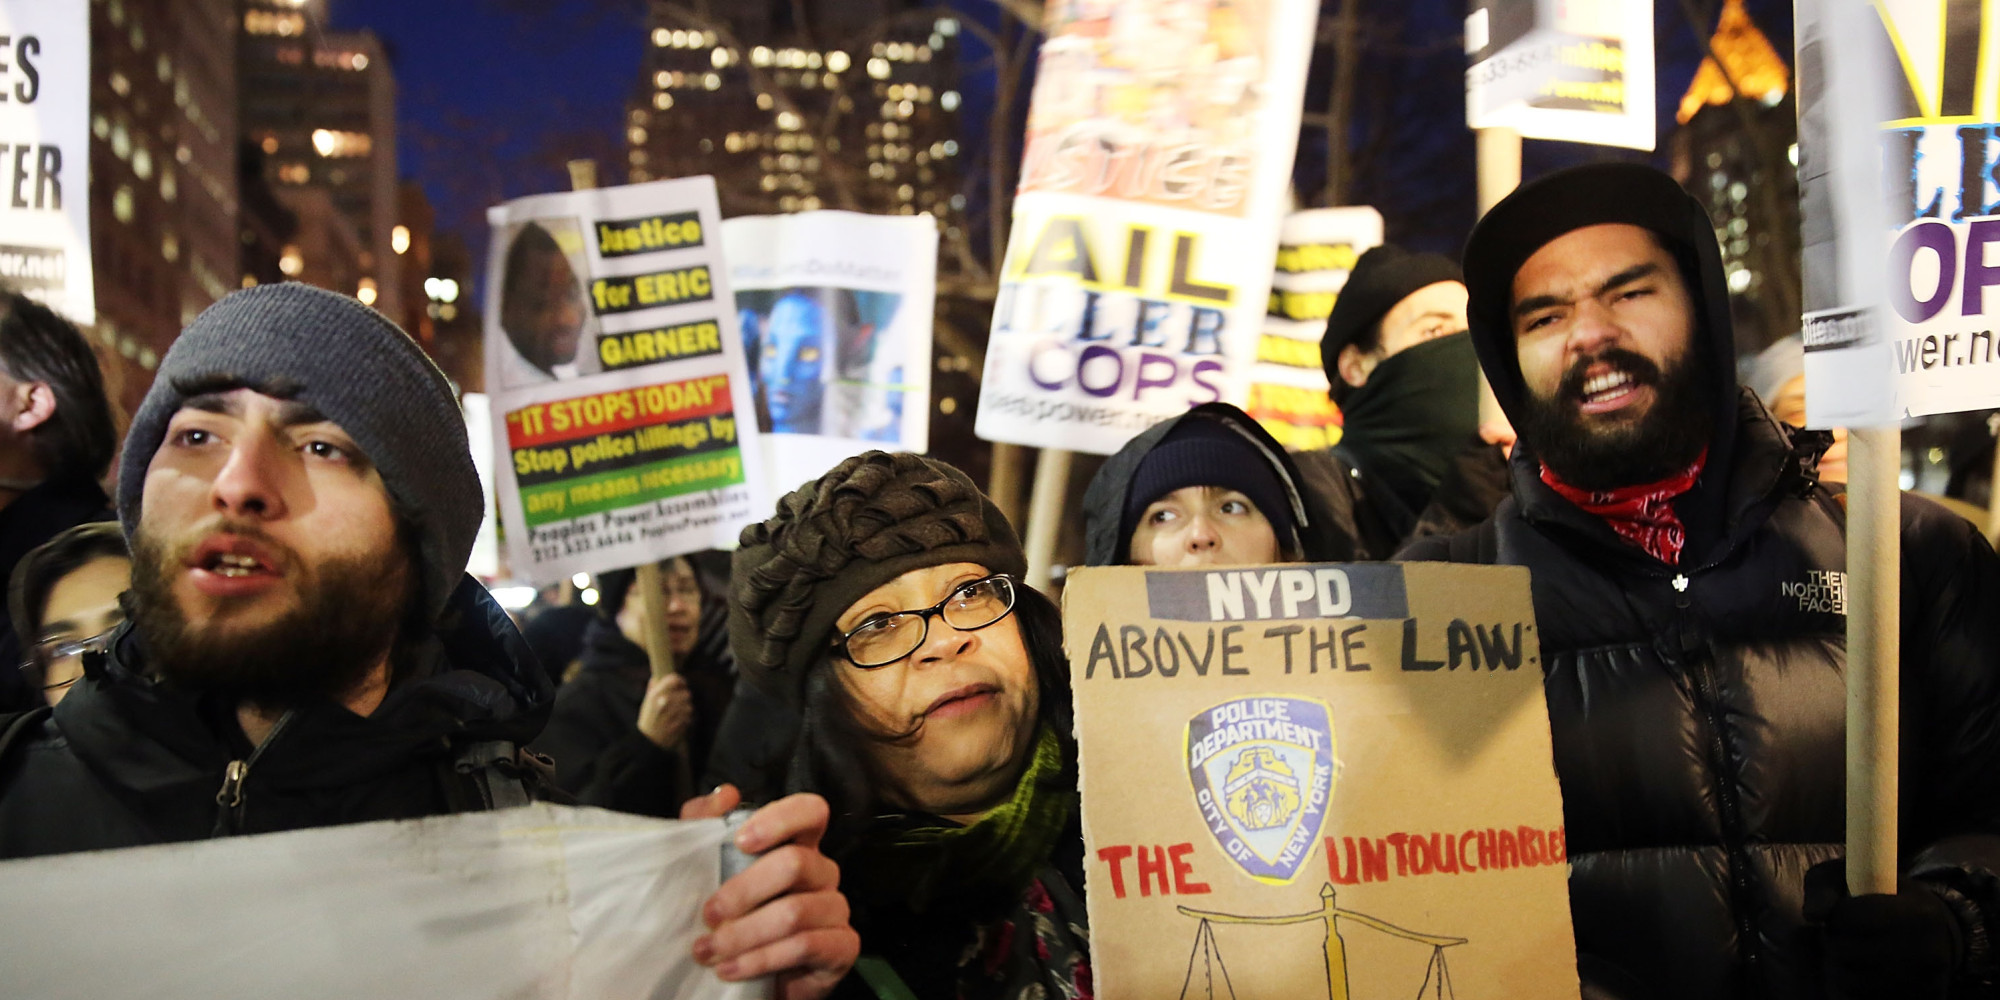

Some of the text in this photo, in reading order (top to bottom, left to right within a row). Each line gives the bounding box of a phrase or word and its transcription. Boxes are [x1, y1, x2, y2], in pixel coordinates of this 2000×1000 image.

[601, 217, 701, 252] Justice
[592, 267, 711, 309] for ERIC
[601, 322, 720, 366] GARNER
[1028, 338, 1225, 411] COPS
[513, 446, 568, 475] Stop
[570, 434, 636, 469] police
[709, 415, 735, 441] by
[527, 490, 566, 514] any
[569, 476, 631, 505] means
[1206, 567, 1353, 622] NYPD
[1781, 580, 1842, 601] NORTH
[1806, 569, 1841, 587] THE
[1798, 597, 1842, 615] FACE
[1085, 616, 1540, 681] ABOVE THE LAW:
[1211, 699, 1291, 730] POLICE
[1191, 718, 1323, 770] DEPARTMENT
[1197, 763, 1330, 869] CITY OF NEW YORK
[1097, 841, 1212, 900] THE
